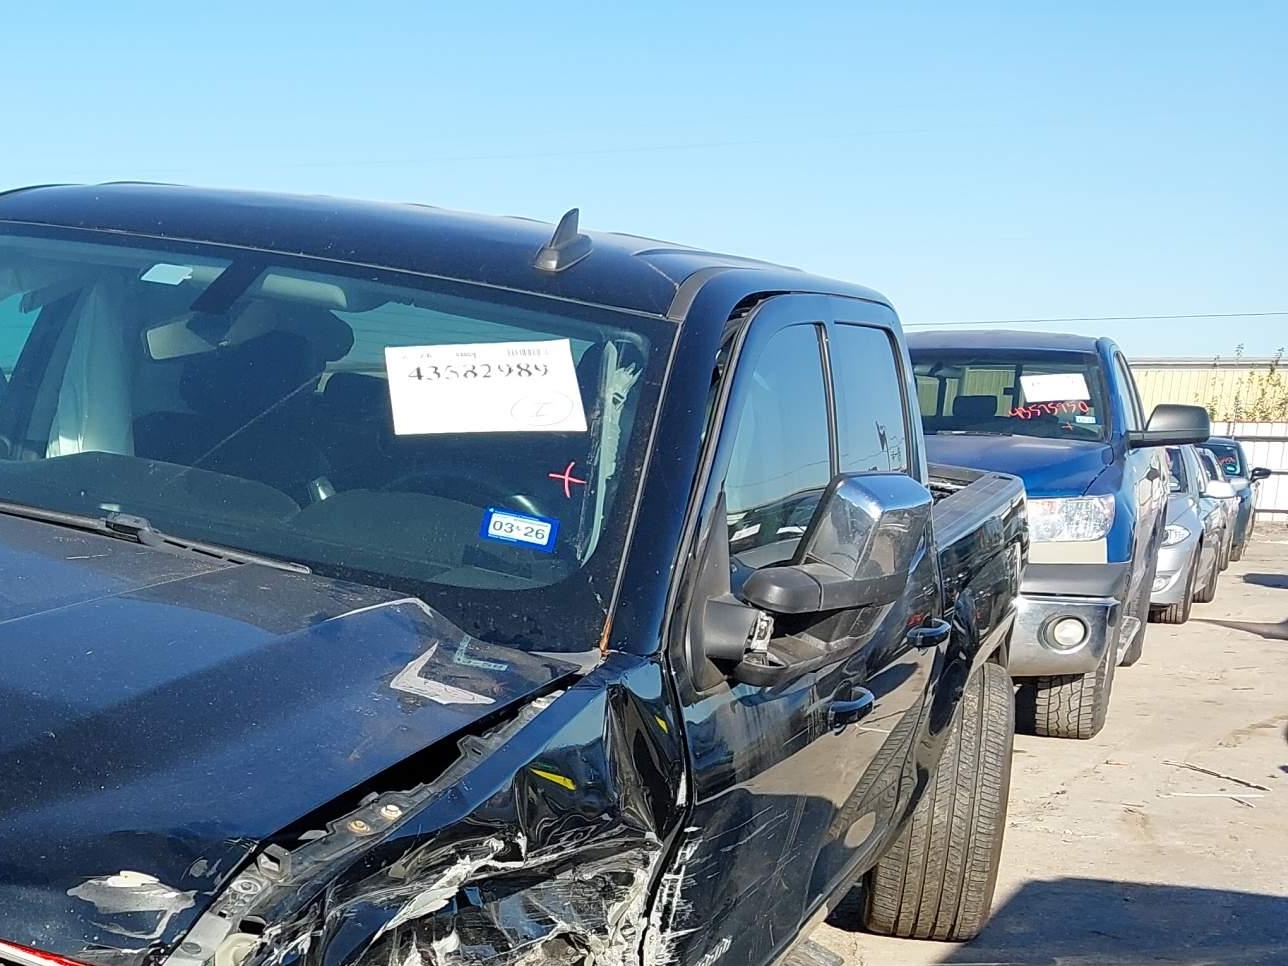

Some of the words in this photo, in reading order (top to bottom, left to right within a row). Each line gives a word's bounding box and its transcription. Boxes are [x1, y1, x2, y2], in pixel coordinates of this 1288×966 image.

[408, 362, 550, 382] 43582989
[492, 520, 515, 534] 03
[523, 526, 547, 540] 26
